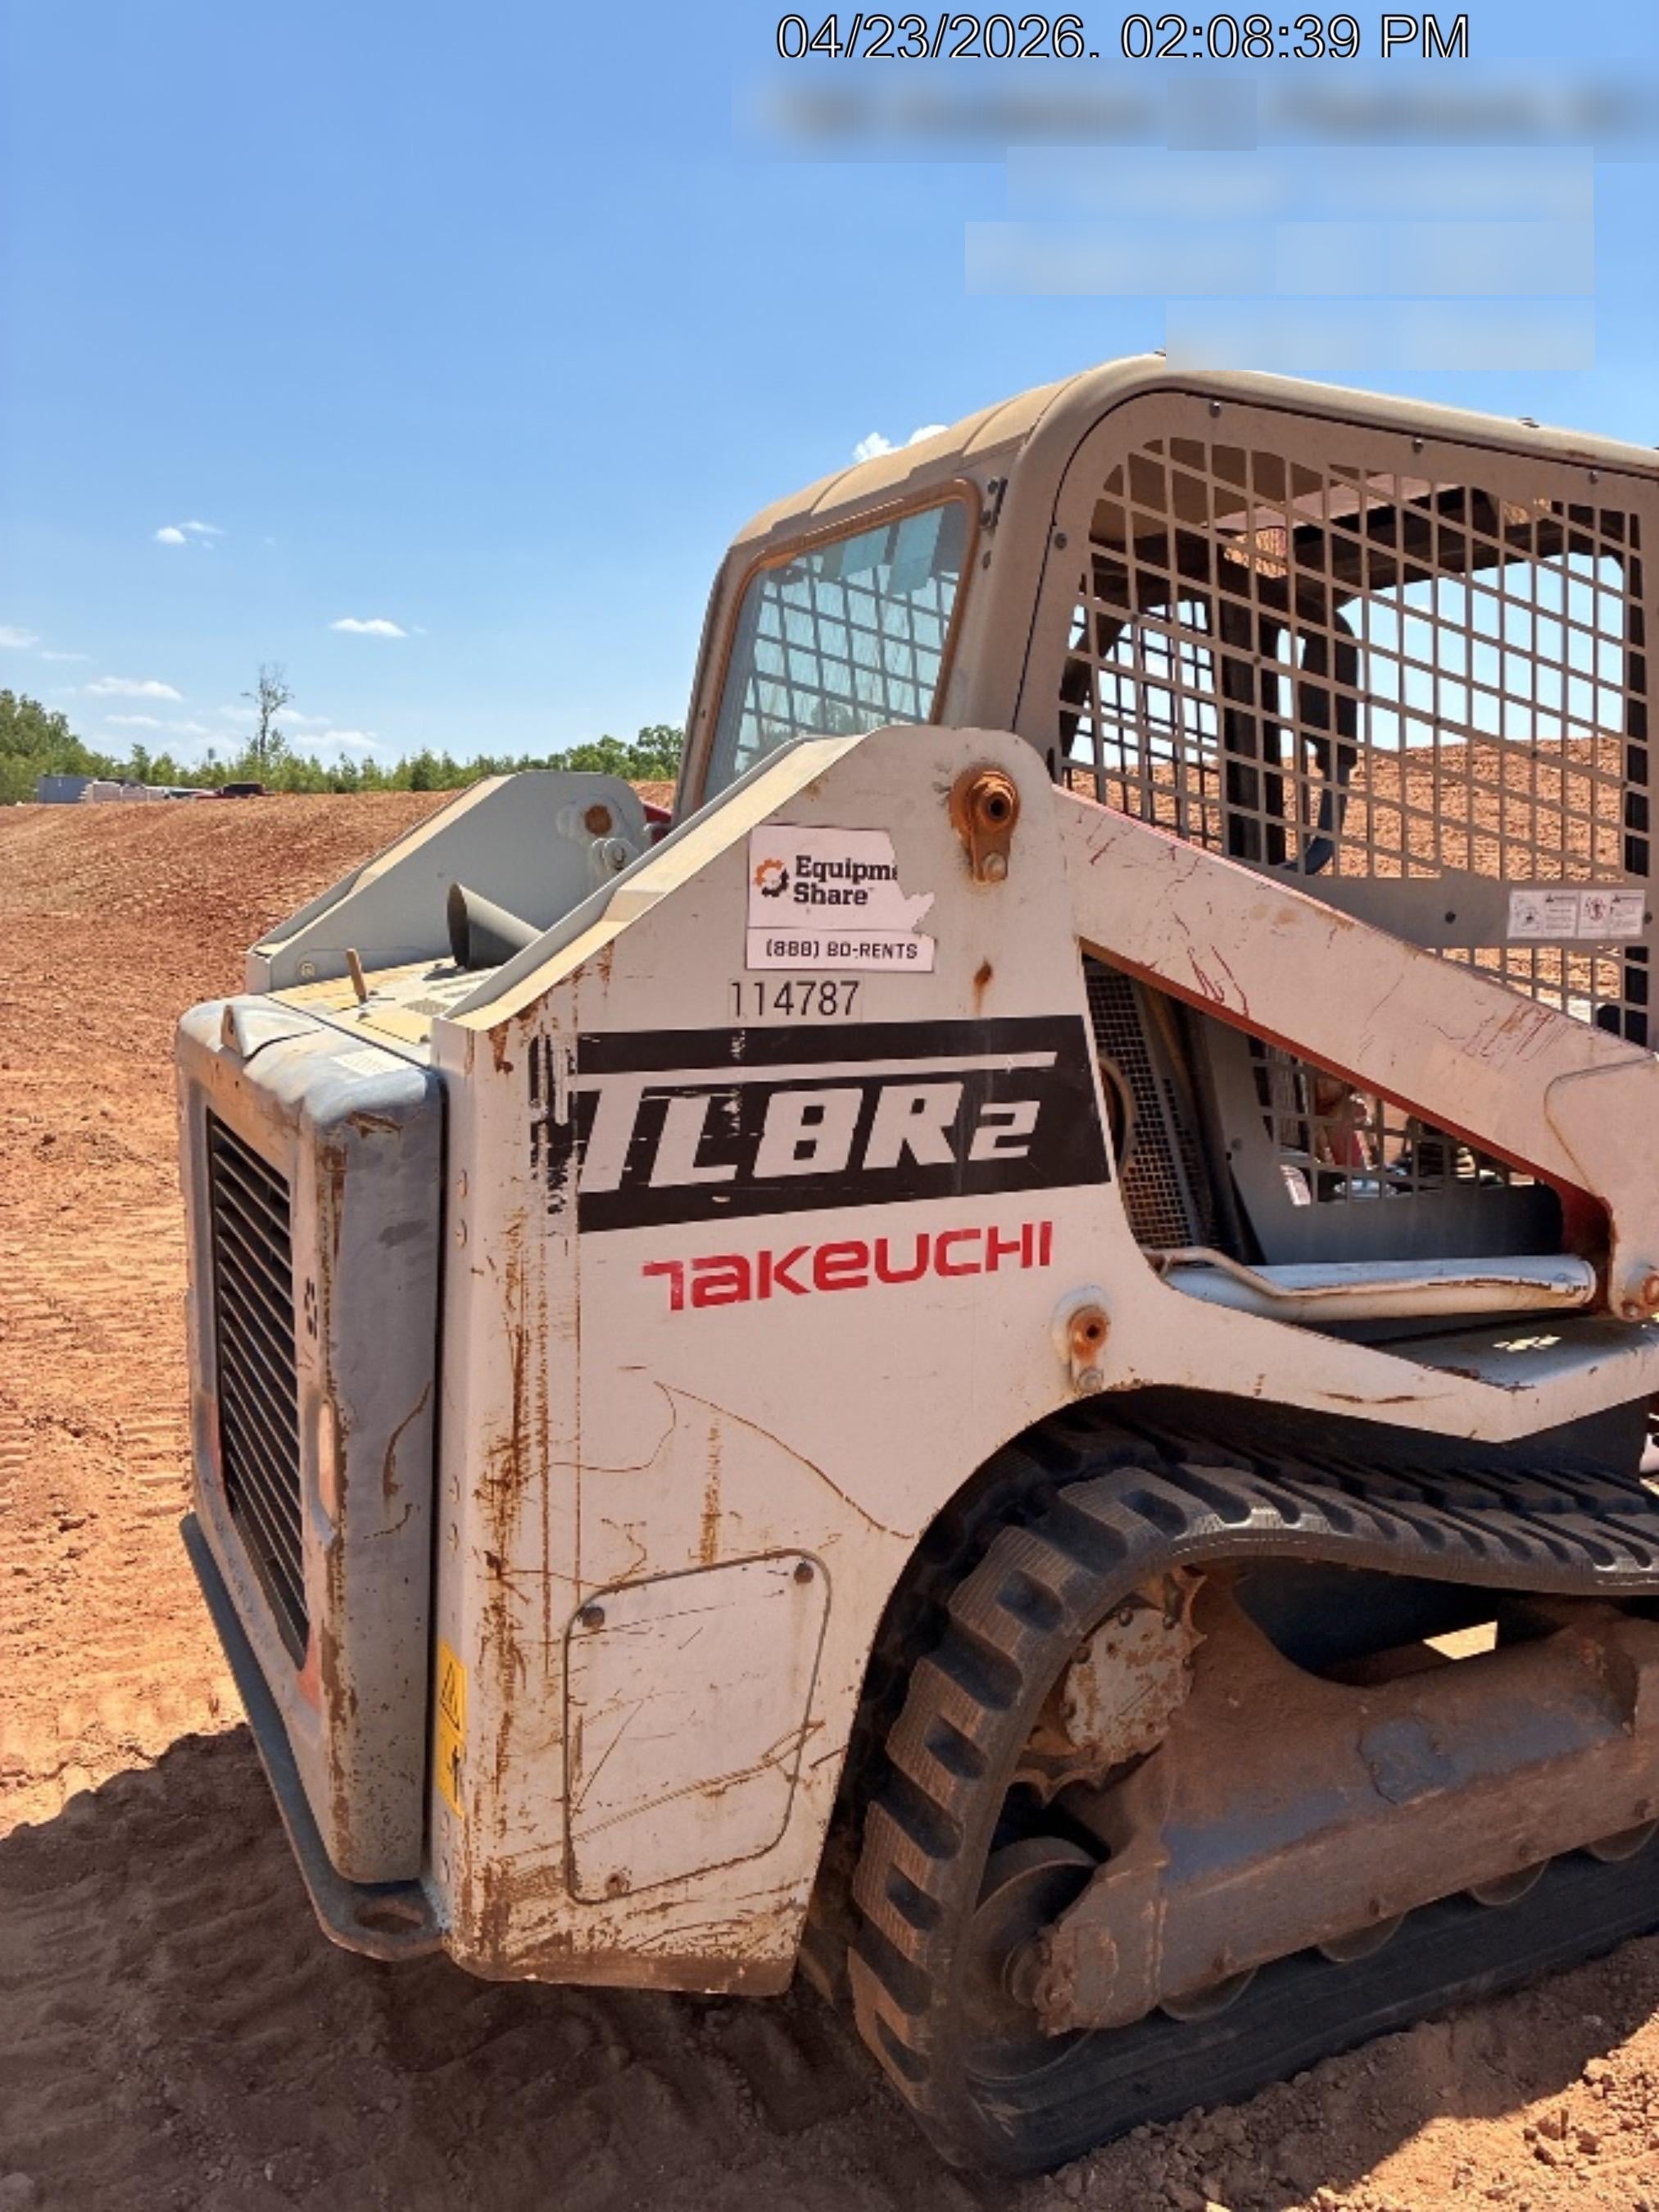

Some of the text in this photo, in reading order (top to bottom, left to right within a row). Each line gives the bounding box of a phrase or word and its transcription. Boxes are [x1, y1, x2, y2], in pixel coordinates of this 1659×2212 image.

[793, 882, 868, 905] Share
[766, 939, 918, 959] (888) 80-RENTS
[732, 981, 859, 1016] 114787
